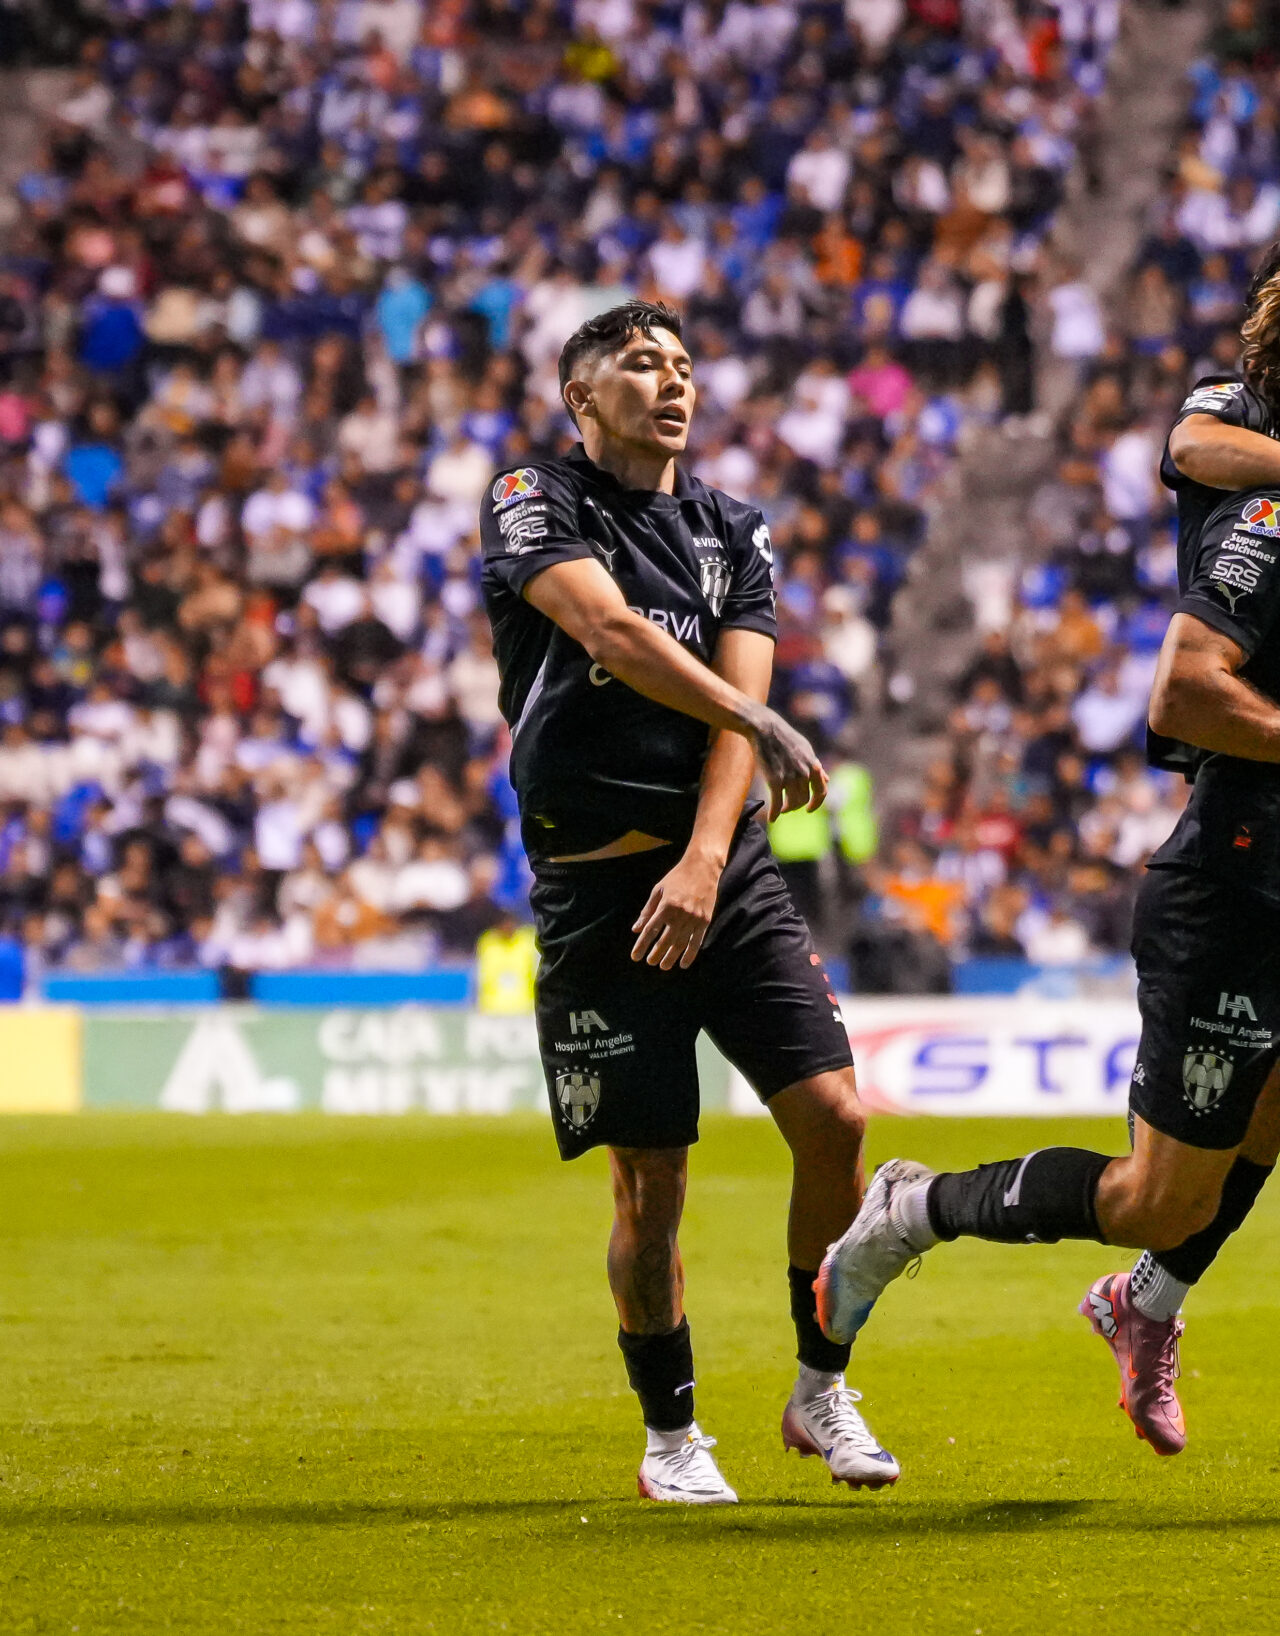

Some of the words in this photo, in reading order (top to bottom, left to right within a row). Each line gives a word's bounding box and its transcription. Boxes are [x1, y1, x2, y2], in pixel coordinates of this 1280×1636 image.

[509, 520, 549, 547] SRS
[1230, 532, 1263, 548] Super
[1221, 540, 1277, 564] Colchones
[1212, 560, 1261, 588] SRS
[1189, 1016, 1235, 1035] Hospital
[554, 1039, 591, 1054] Hospital
[594, 1033, 634, 1050] Angeles
[588, 1051, 609, 1060] VALLE
[609, 1044, 636, 1057] ORIENTE
